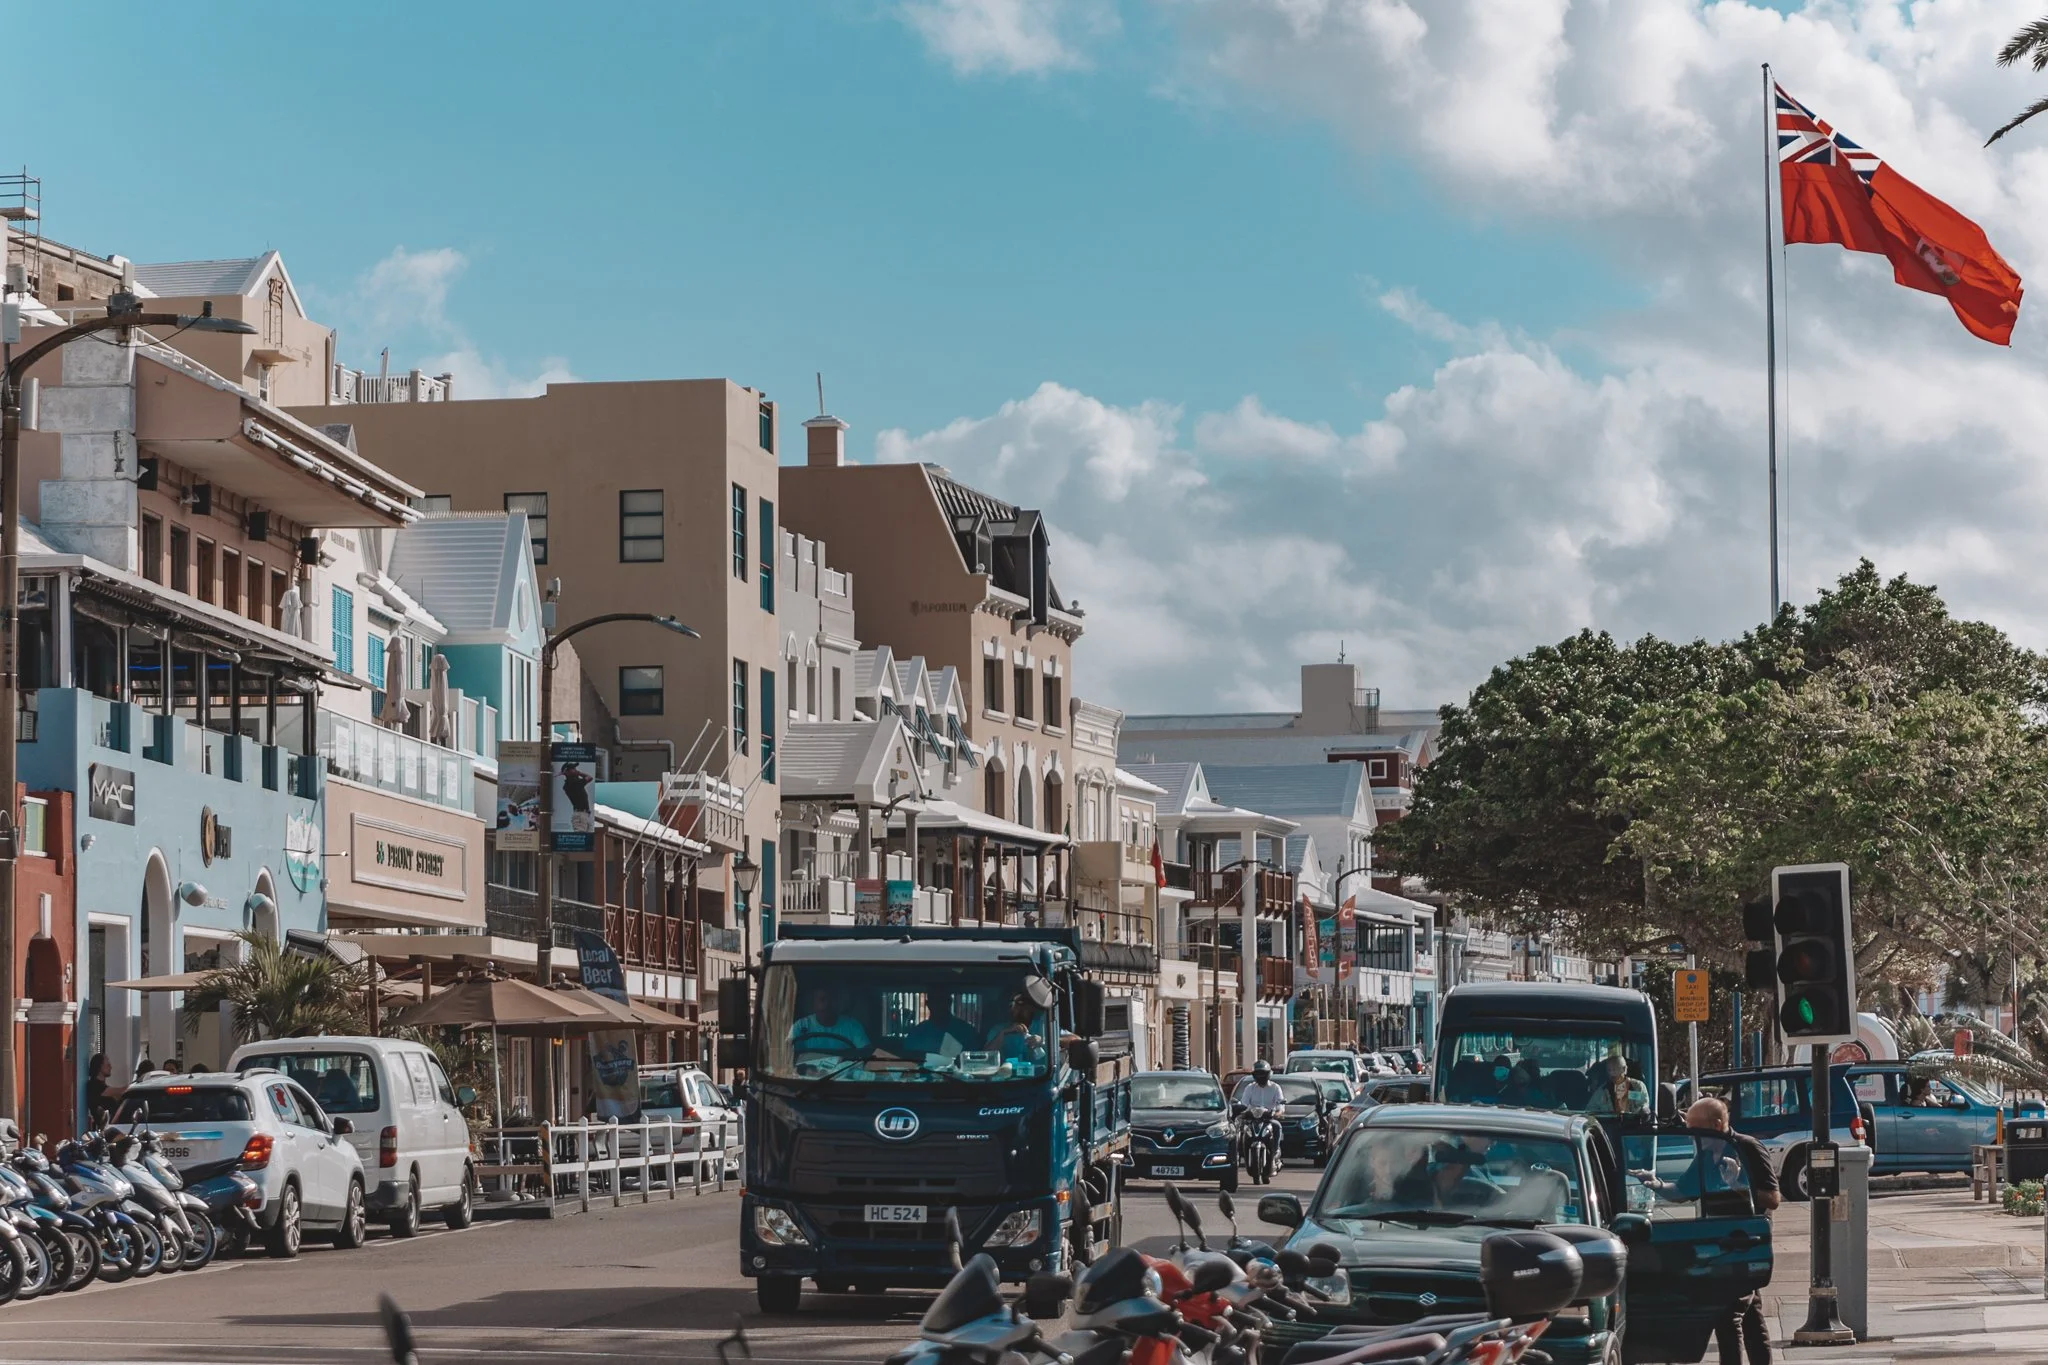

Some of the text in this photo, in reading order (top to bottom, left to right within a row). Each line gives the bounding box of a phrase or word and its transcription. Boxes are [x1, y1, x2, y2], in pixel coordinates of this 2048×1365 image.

[387, 843, 414, 871] FRONT
[416, 849, 444, 877] STREET
[580, 948, 609, 962] Local
[583, 966, 612, 984] Beer
[879, 1116, 915, 1131] UD
[871, 1207, 921, 1221] HC 524
